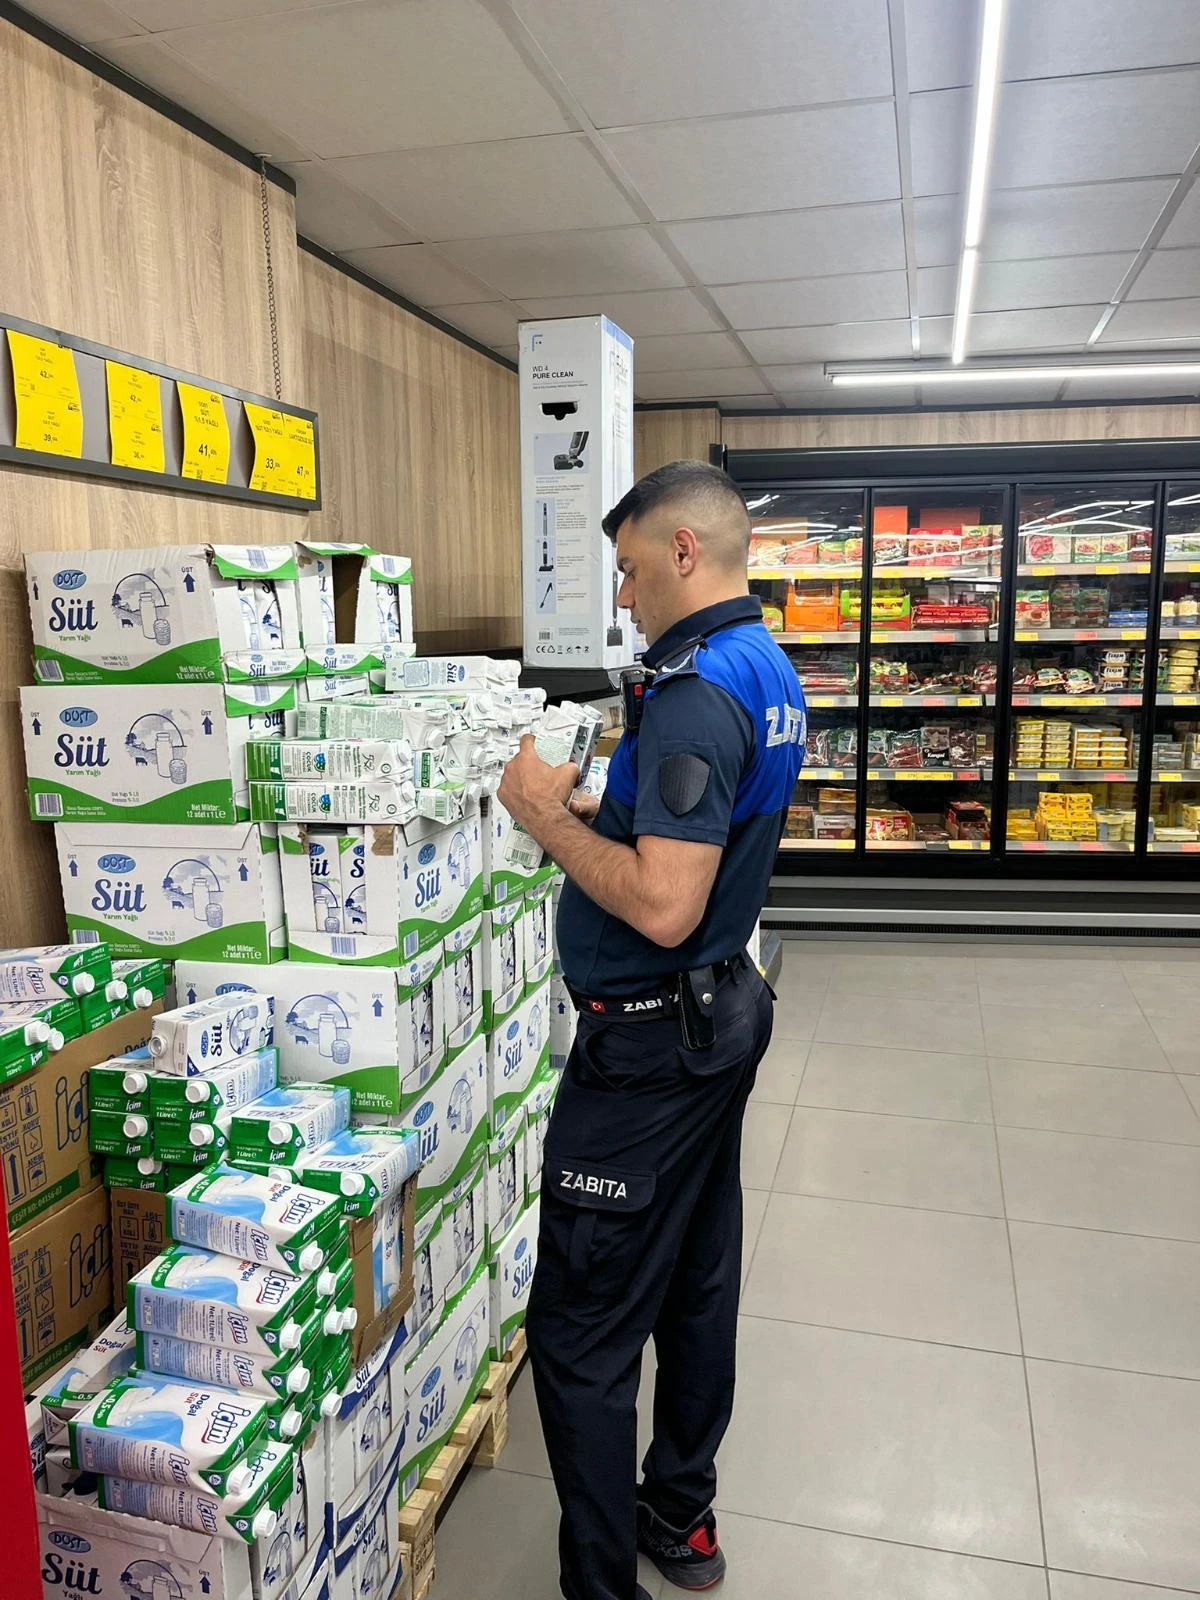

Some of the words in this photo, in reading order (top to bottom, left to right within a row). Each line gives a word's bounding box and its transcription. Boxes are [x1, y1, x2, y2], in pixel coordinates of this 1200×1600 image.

[57, 572, 83, 586] DOST
[49, 597, 98, 632] Süt
[250, 664, 266, 678] Süt
[323, 656, 337, 669] Süt
[447, 663, 458, 683] Süt
[325, 679, 336, 690] Süt
[65, 710, 93, 724] DOST
[54, 734, 110, 768] Süt
[103, 856, 131, 870] DOST
[91, 879, 147, 912] Süt
[415, 867, 441, 908] Süt
[122, 914, 138, 922] Yağlı
[210, 1022, 223, 1056] Süt
[504, 1039, 522, 1077] Süt
[126, 1100, 141, 1111] İçim
[190, 1109, 205, 1120] İçim
[126, 1143, 141, 1154] İçim
[421, 1122, 441, 1160] üt
[193, 1151, 207, 1163] İçim
[270, 1150, 285, 1161] İçim
[270, 1185, 291, 1202] Doğal
[560, 1171, 627, 1199] ZABITA
[284, 1193, 326, 1224] İçim
[344, 1200, 360, 1212] İçim
[251, 1228, 269, 1261] İçim
[260, 1270, 301, 1304] İçim
[512, 1254, 533, 1298] Süt
[229, 1311, 249, 1344] İçim
[93, 1345, 107, 1353] Süt
[99, 1339, 126, 1349] Doğal
[234, 1354, 254, 1387] İçim
[356, 1361, 370, 1389] Süt
[184, 1392, 199, 1404] Süt
[187, 1394, 210, 1416] Doğal
[207, 1402, 252, 1444] İçim
[416, 1384, 446, 1442] Süt
[198, 1498, 218, 1533] İçim
[54, 1535, 86, 1549] DOST
[362, 1520, 377, 1553] Süt
[42, 1553, 102, 1595] Süt
